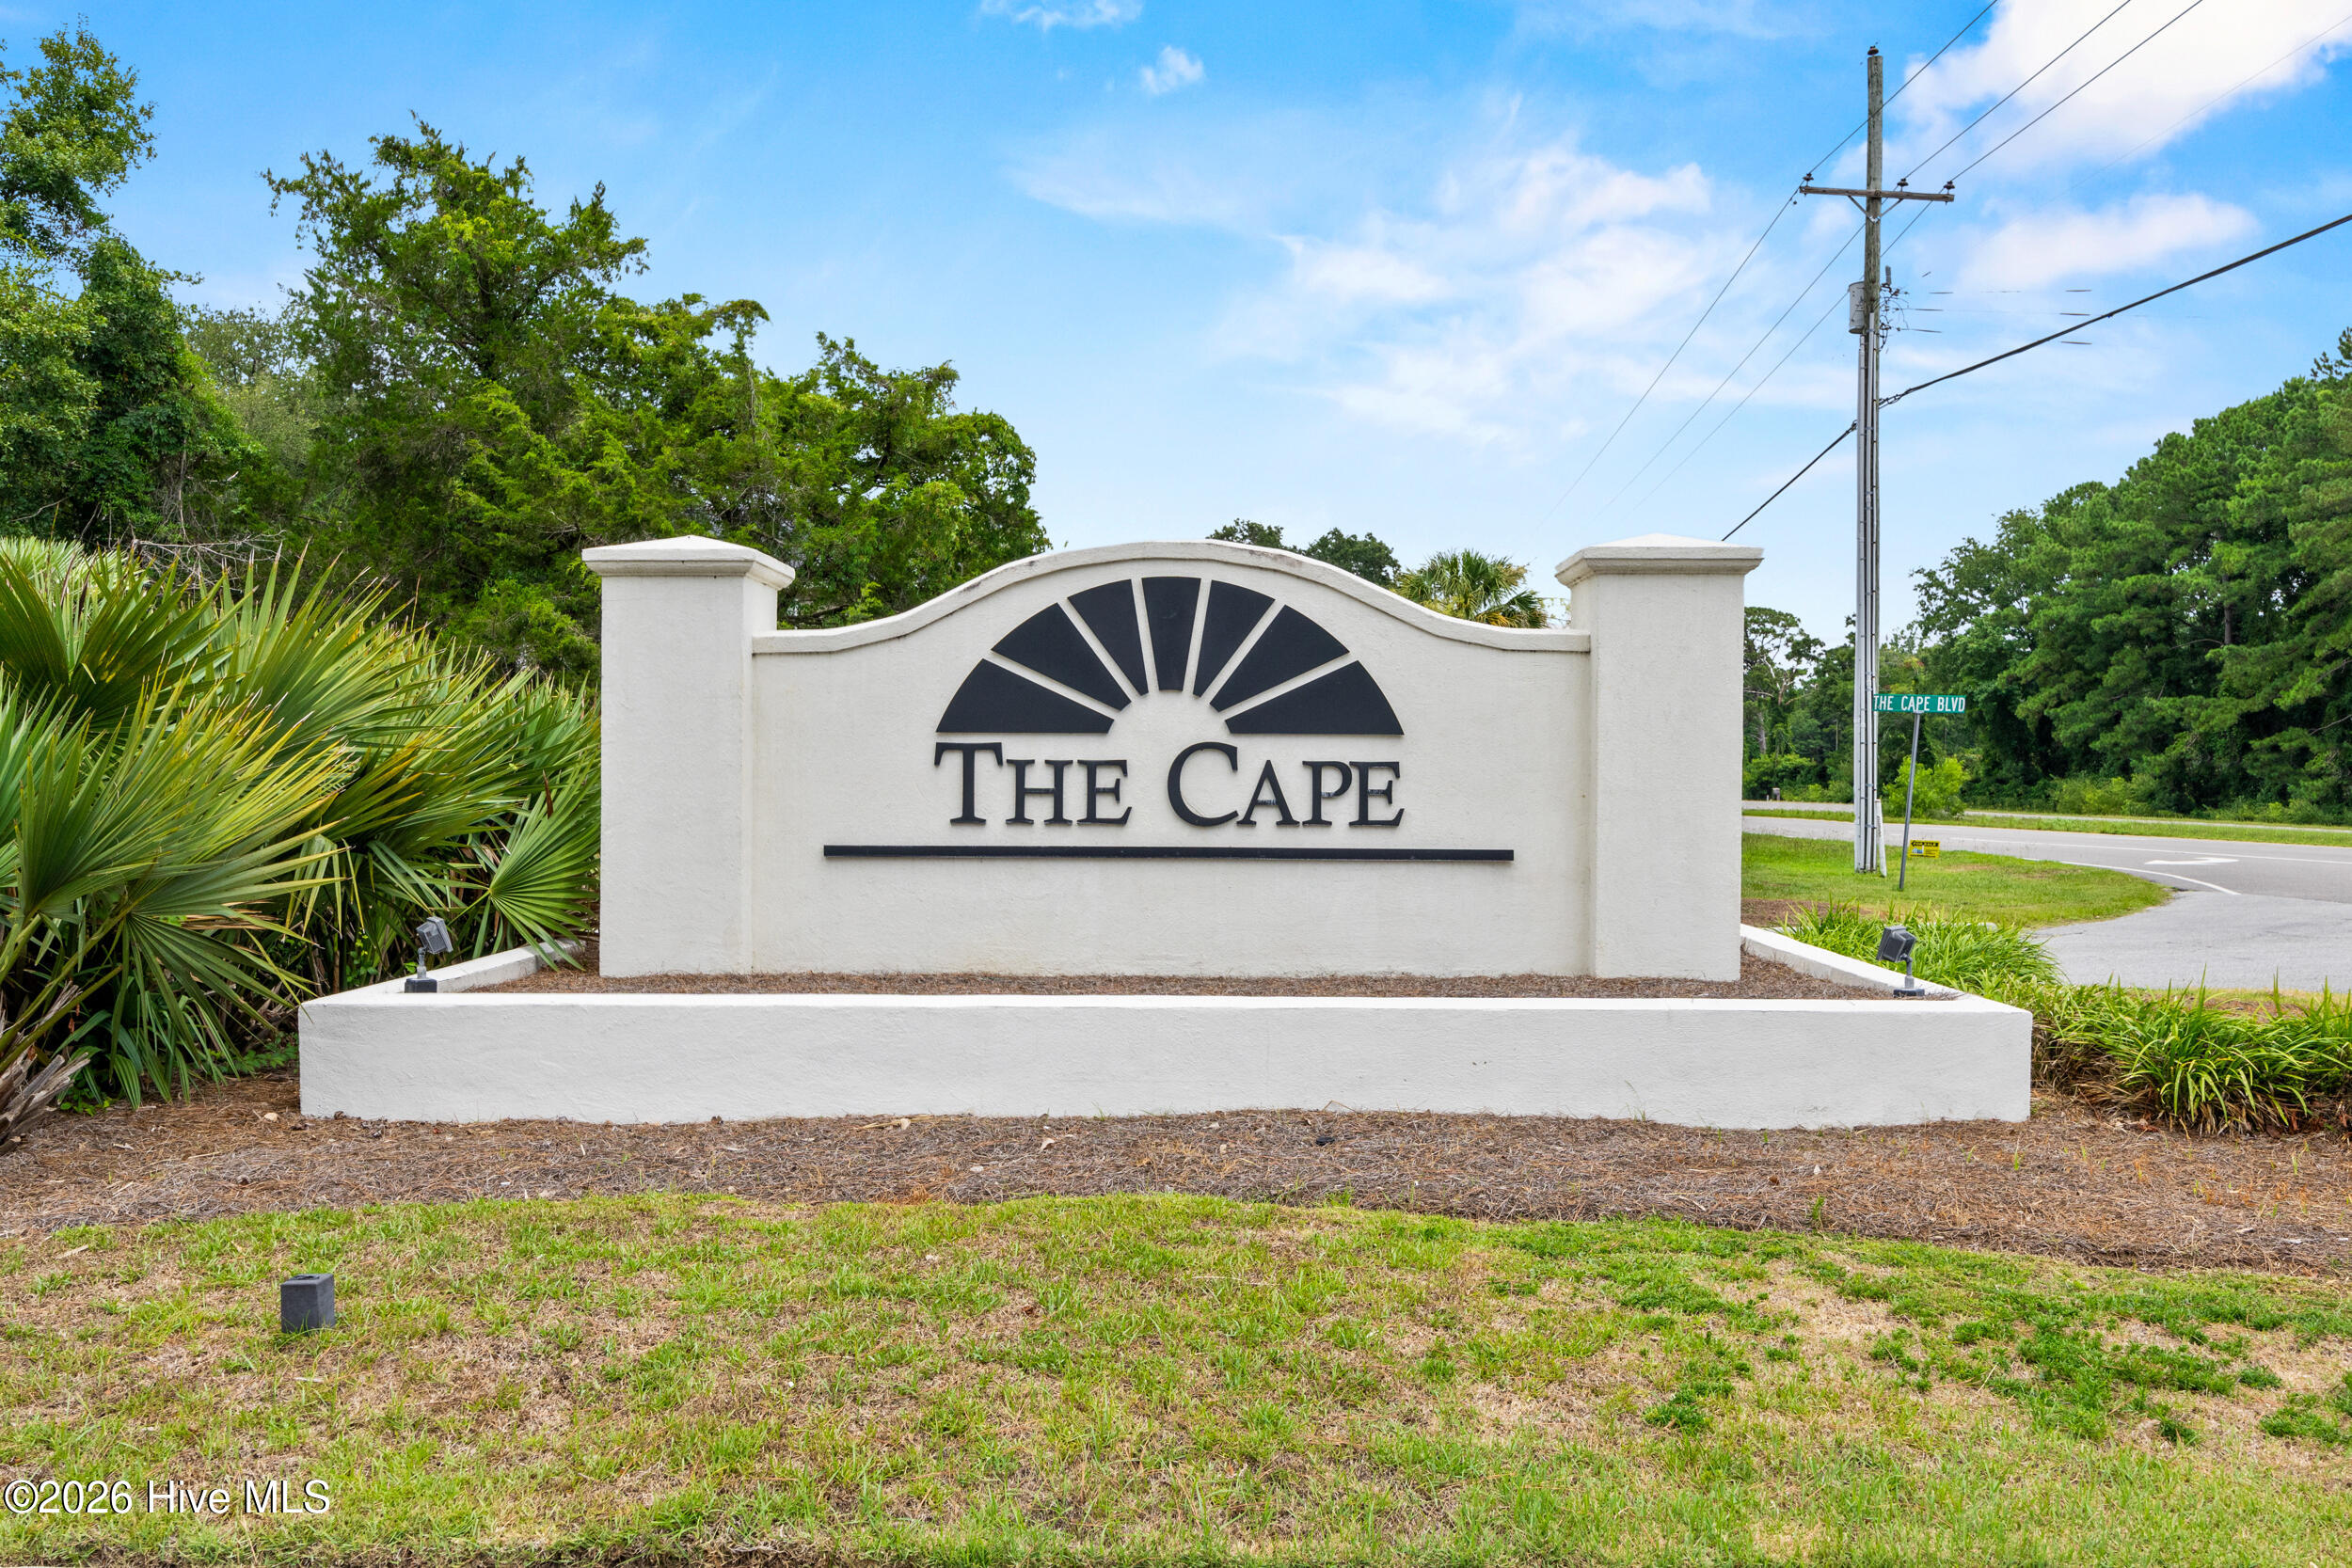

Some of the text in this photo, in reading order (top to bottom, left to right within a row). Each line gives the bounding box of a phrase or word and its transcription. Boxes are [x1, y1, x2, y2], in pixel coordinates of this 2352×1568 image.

[1874, 695, 1965, 712] THE CAPE BLVD
[934, 741, 1405, 827] THE CAPE
